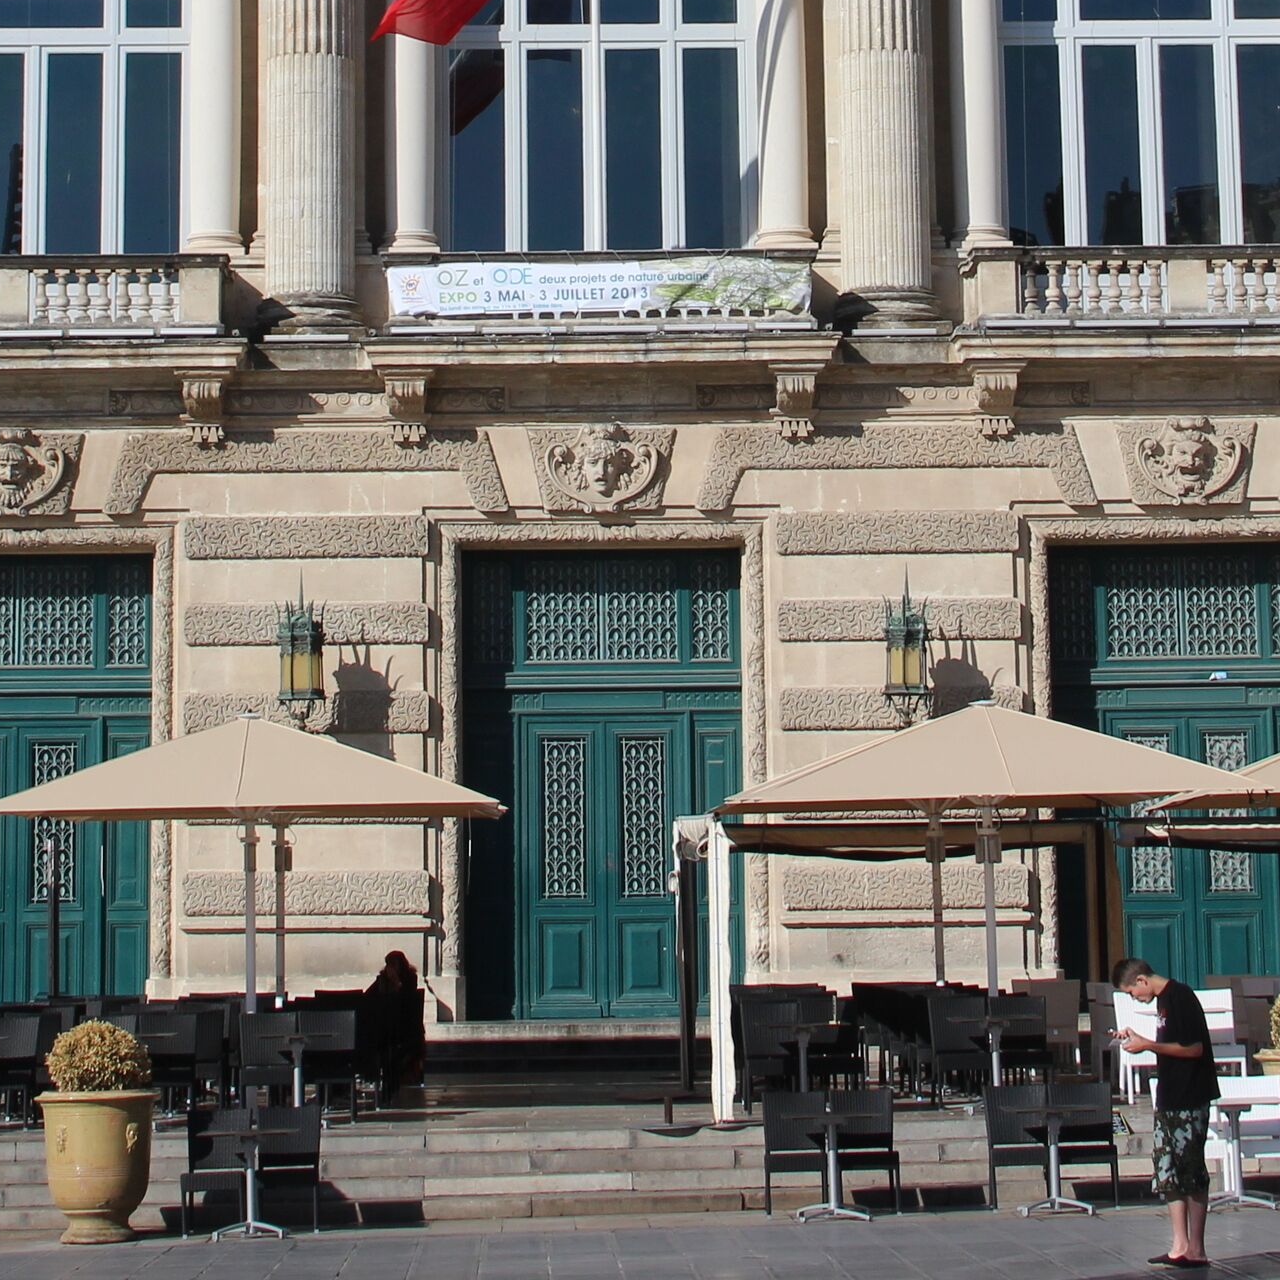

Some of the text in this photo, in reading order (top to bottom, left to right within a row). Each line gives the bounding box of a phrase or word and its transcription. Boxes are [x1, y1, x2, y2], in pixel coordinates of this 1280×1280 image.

[437, 268, 709, 286] OZ et ODE deux projets de nature urbaine
[439, 287, 648, 304] EXPO 3 MAI 3 JUILLET 2013
